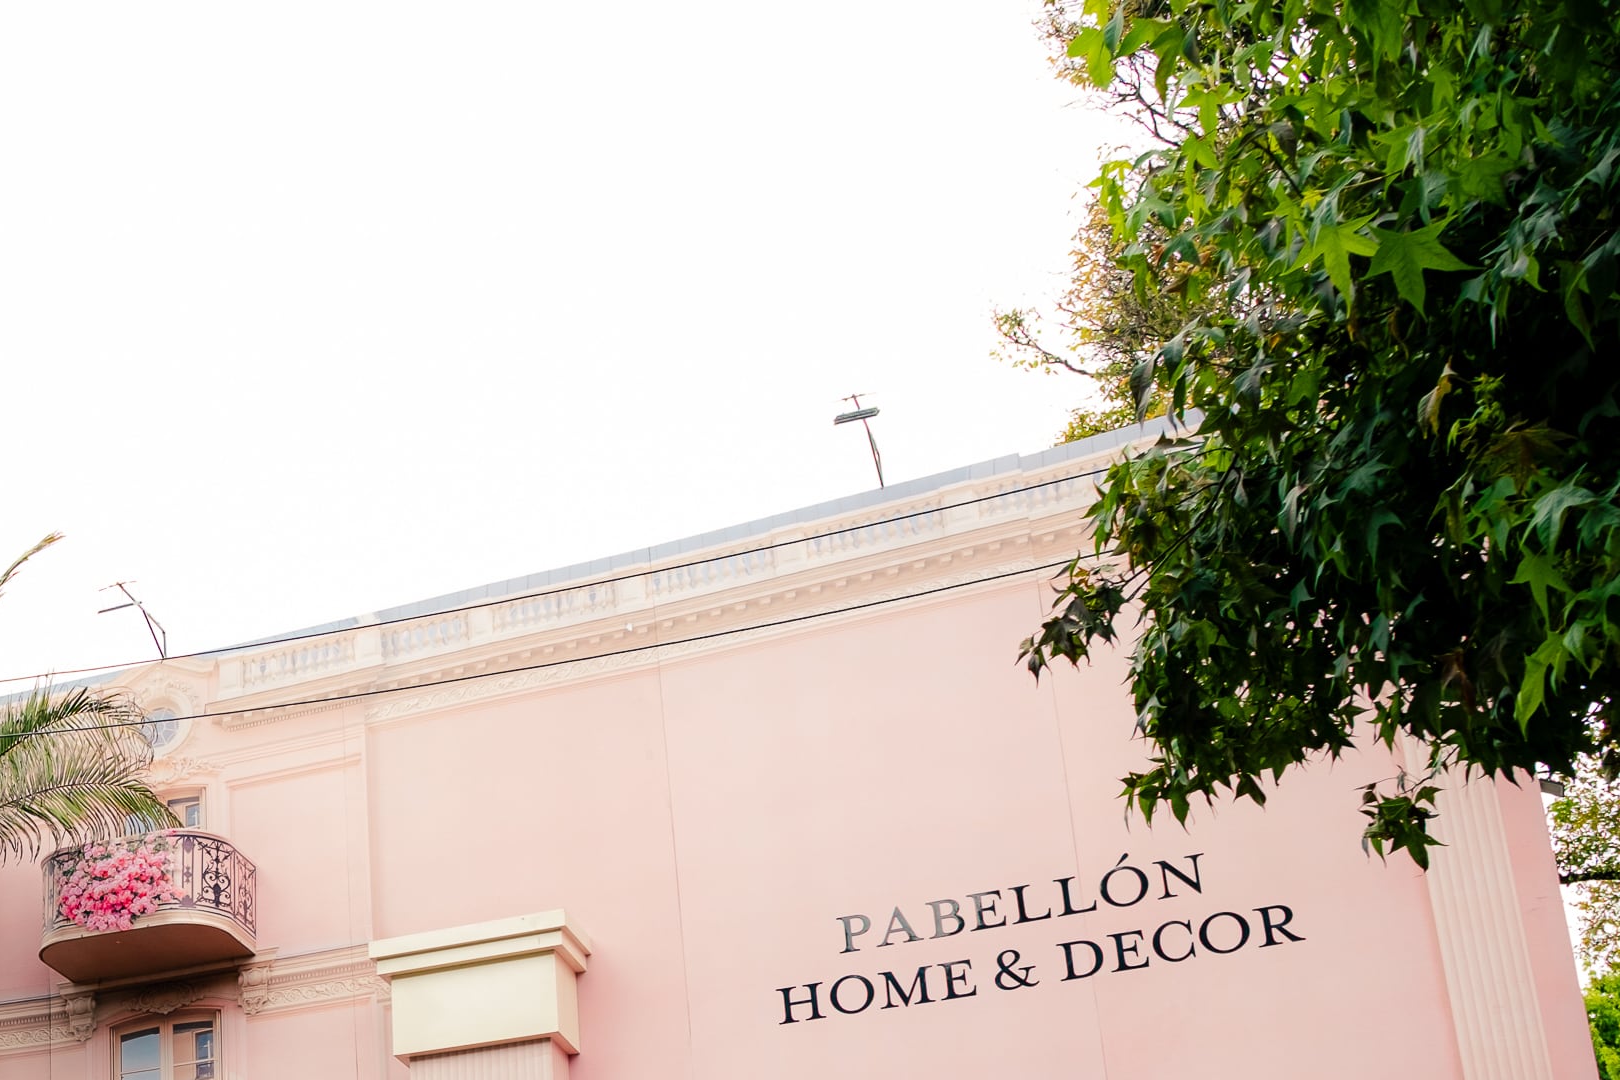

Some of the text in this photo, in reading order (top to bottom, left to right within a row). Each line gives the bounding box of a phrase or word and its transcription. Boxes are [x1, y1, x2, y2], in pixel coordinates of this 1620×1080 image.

[836, 853, 1204, 953] PABELLÓN
[776, 904, 1307, 1025] HOME & DECOR
